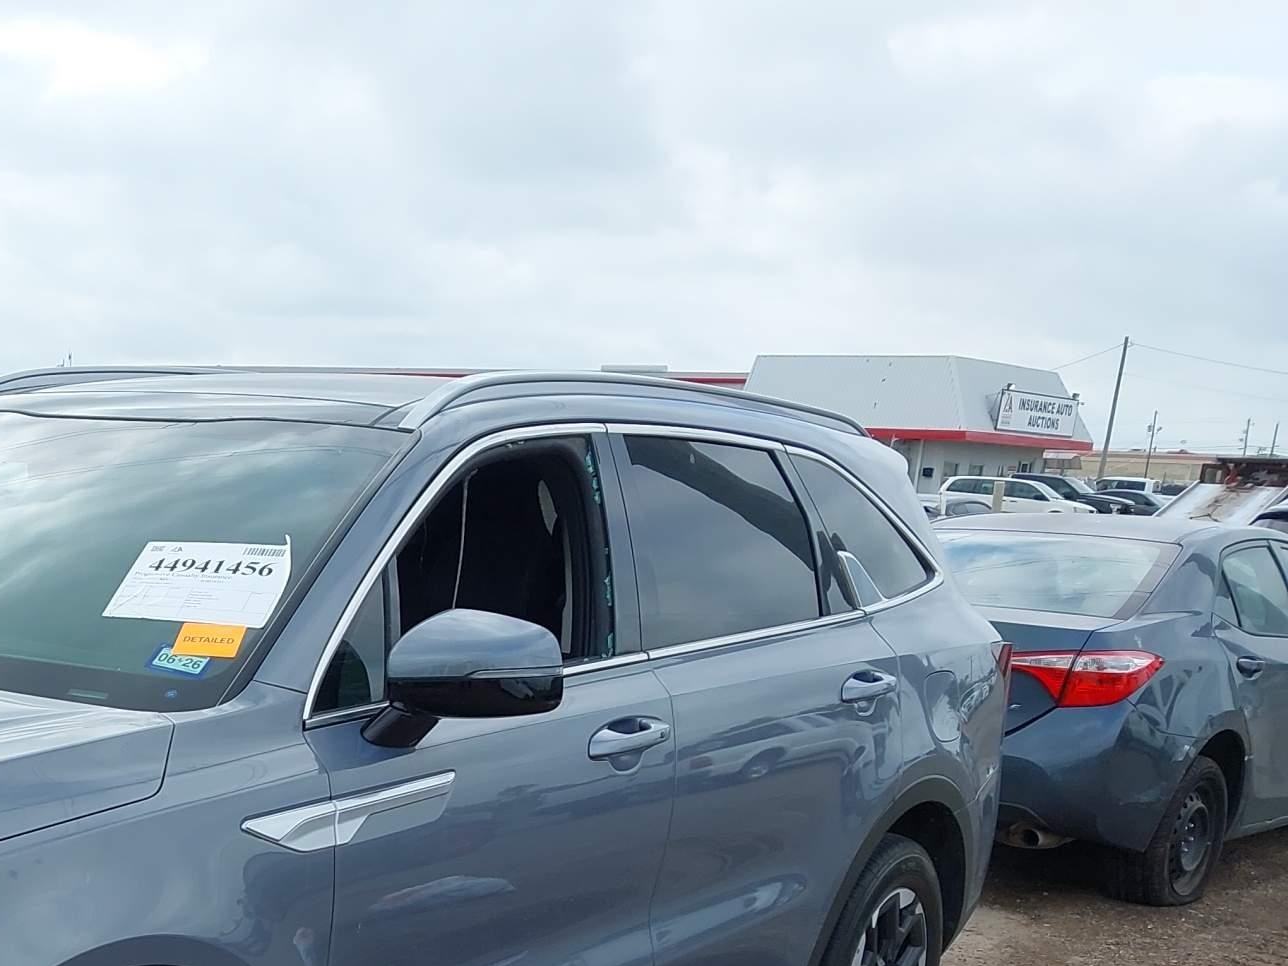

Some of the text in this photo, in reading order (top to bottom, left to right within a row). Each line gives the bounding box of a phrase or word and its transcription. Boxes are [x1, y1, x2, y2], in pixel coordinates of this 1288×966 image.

[1018, 398, 1073, 416] INSURANCE AUTO
[1027, 415, 1060, 430] AUCTIONS
[149, 557, 278, 577] 44941456
[182, 636, 235, 645] DETAILED
